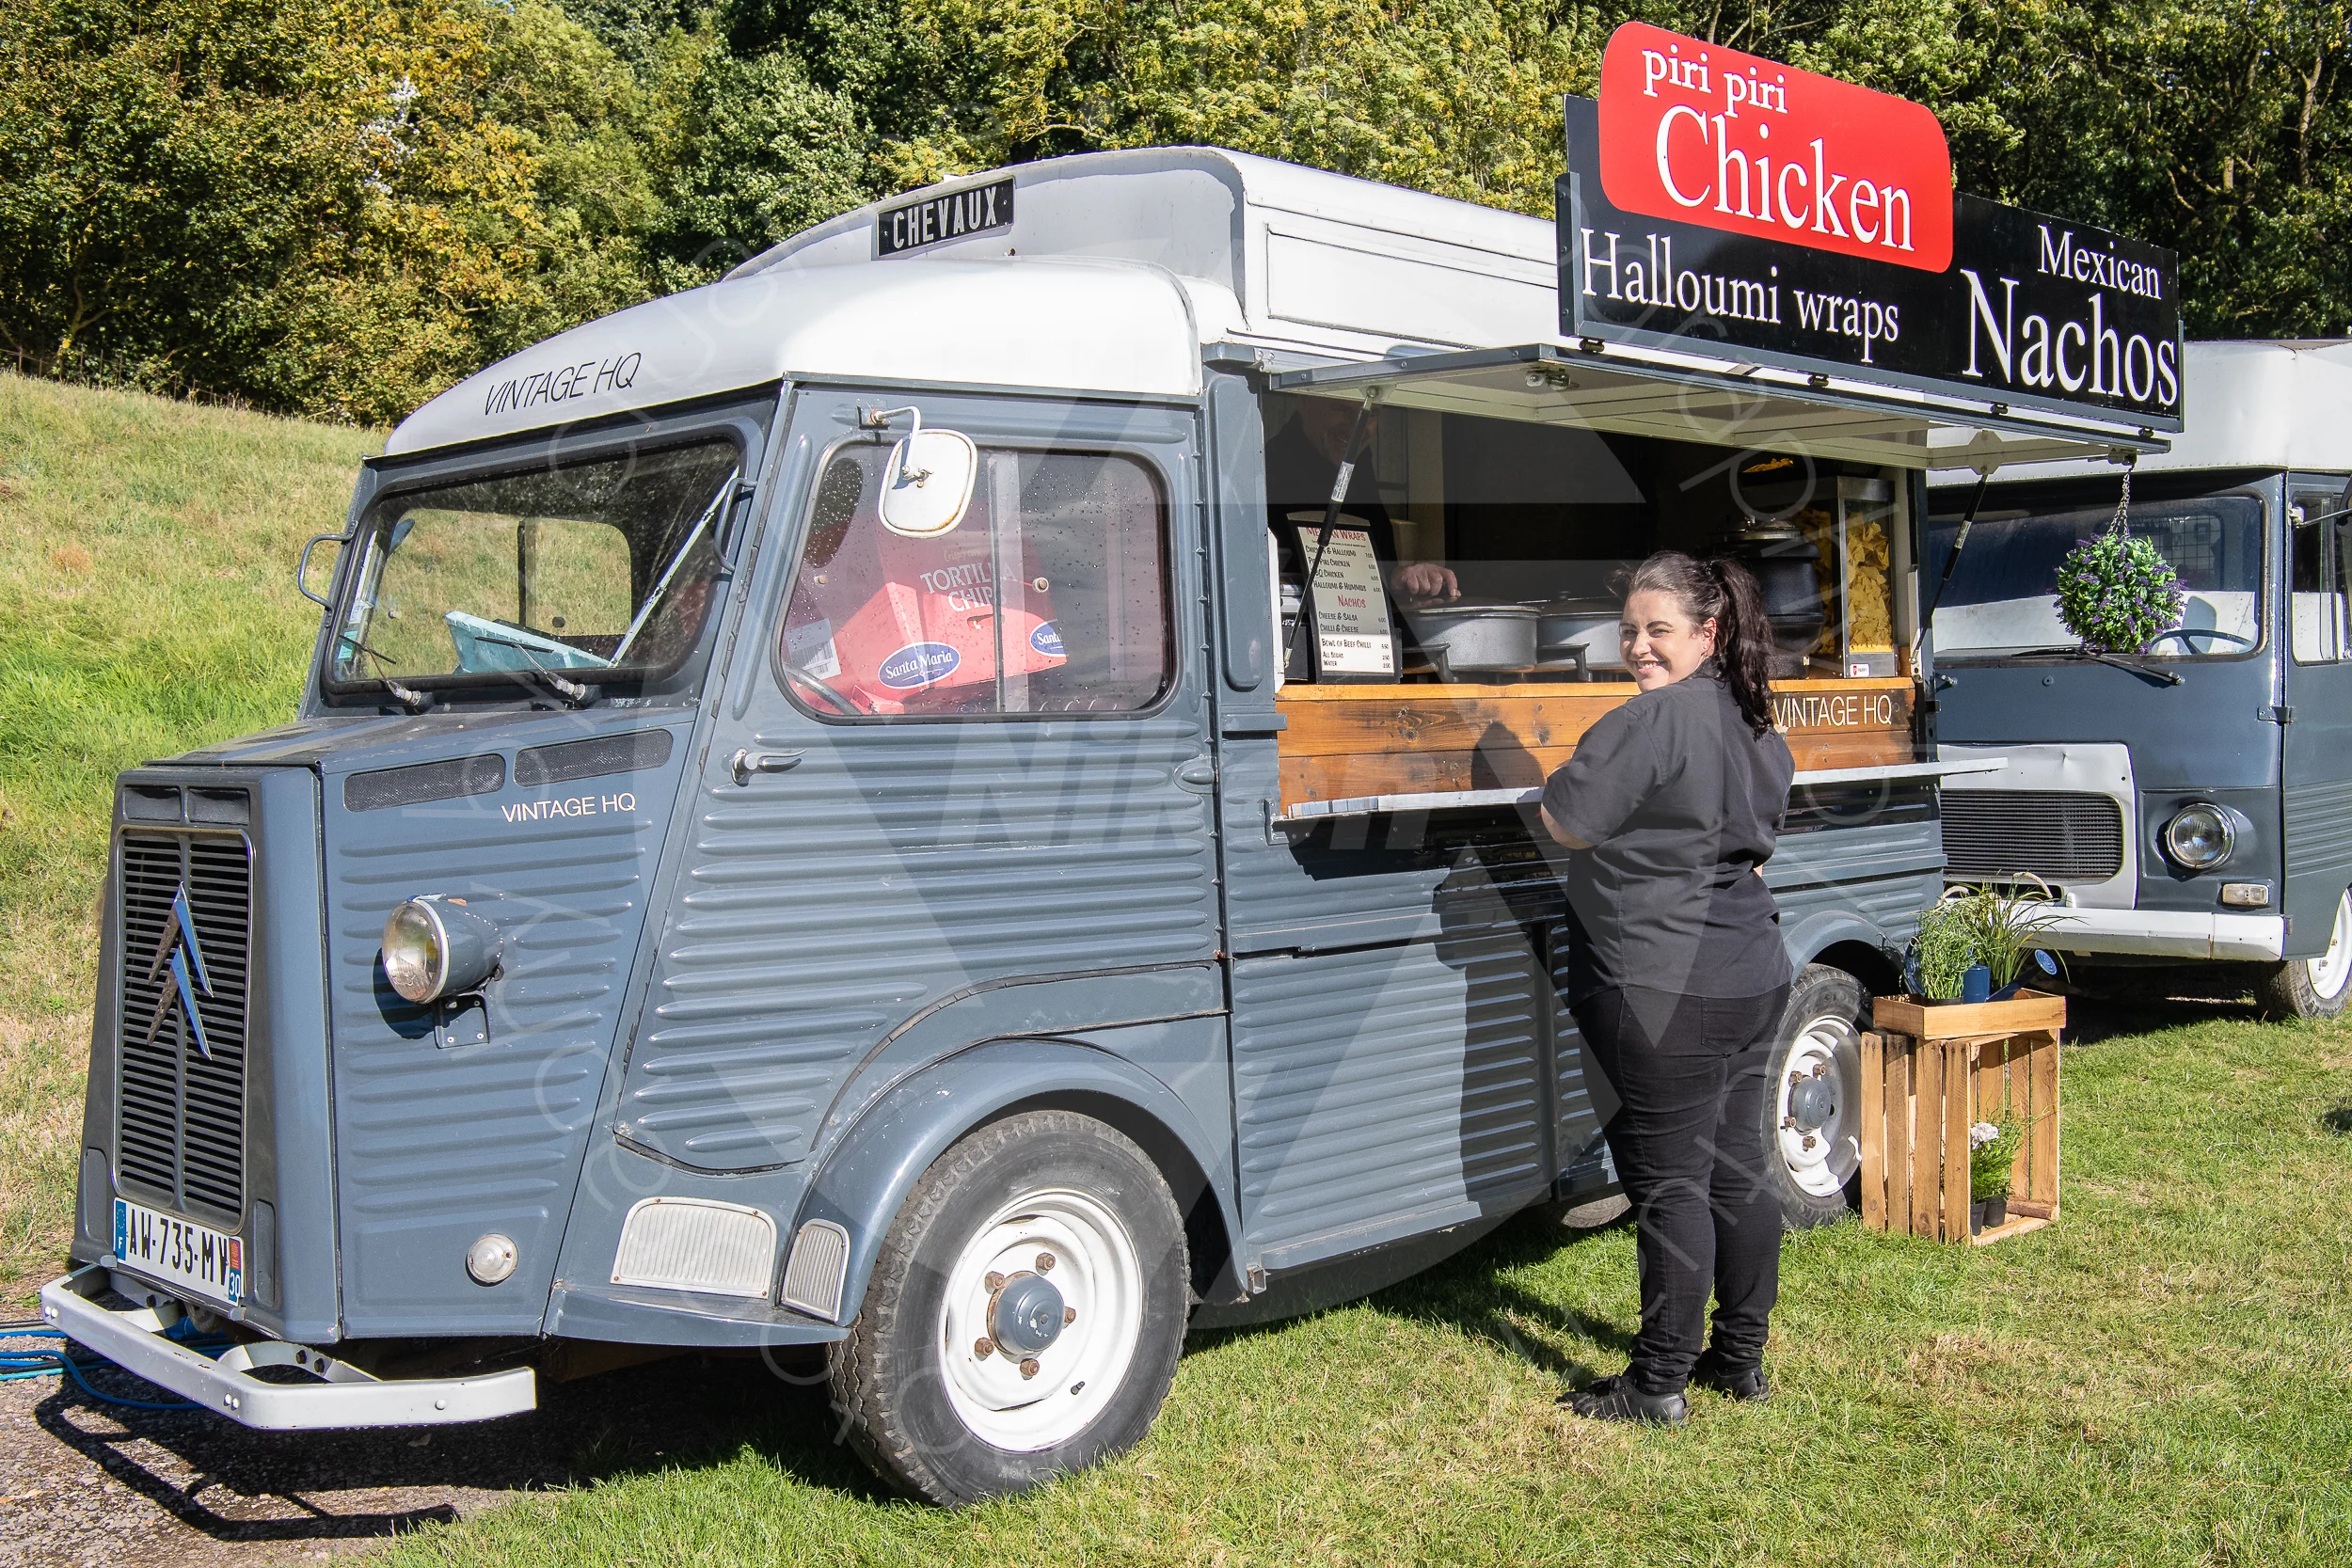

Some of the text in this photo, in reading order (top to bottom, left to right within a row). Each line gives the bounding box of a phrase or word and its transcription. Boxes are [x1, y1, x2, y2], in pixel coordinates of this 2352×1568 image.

[1642, 43, 1788, 119] piri piri
[1656, 104, 1915, 253] Chicken
[894, 186, 997, 249] CHEVAUX
[2037, 224, 2162, 300] Mexican
[1581, 228, 1899, 363] Halloumi wraps
[1961, 268, 2178, 406] Nachos
[485, 352, 642, 416] VINTAGE HQ
[1306, 527, 1366, 541] MEAN WRAPS
[1306, 546, 1326, 554] CHICN
[1330, 559, 1351, 567] CHICKEN
[920, 562, 1018, 594] TORTILA
[1324, 569, 1344, 578] CHICKEN
[1338, 594, 1366, 608] NACHOS
[1318, 611, 1336, 620] CHEESE
[1343, 612, 1359, 621] SALSA
[1342, 625, 1359, 633] CHEESE
[1036, 631, 1062, 646] Santa
[885, 651, 953, 678] Santa Maria
[1773, 694, 1892, 728] VINTAGE HQ
[501, 792, 636, 823] VINTAGE HQ
[118, 1237, 123, 1249] F
[230, 1272, 241, 1297] 30
